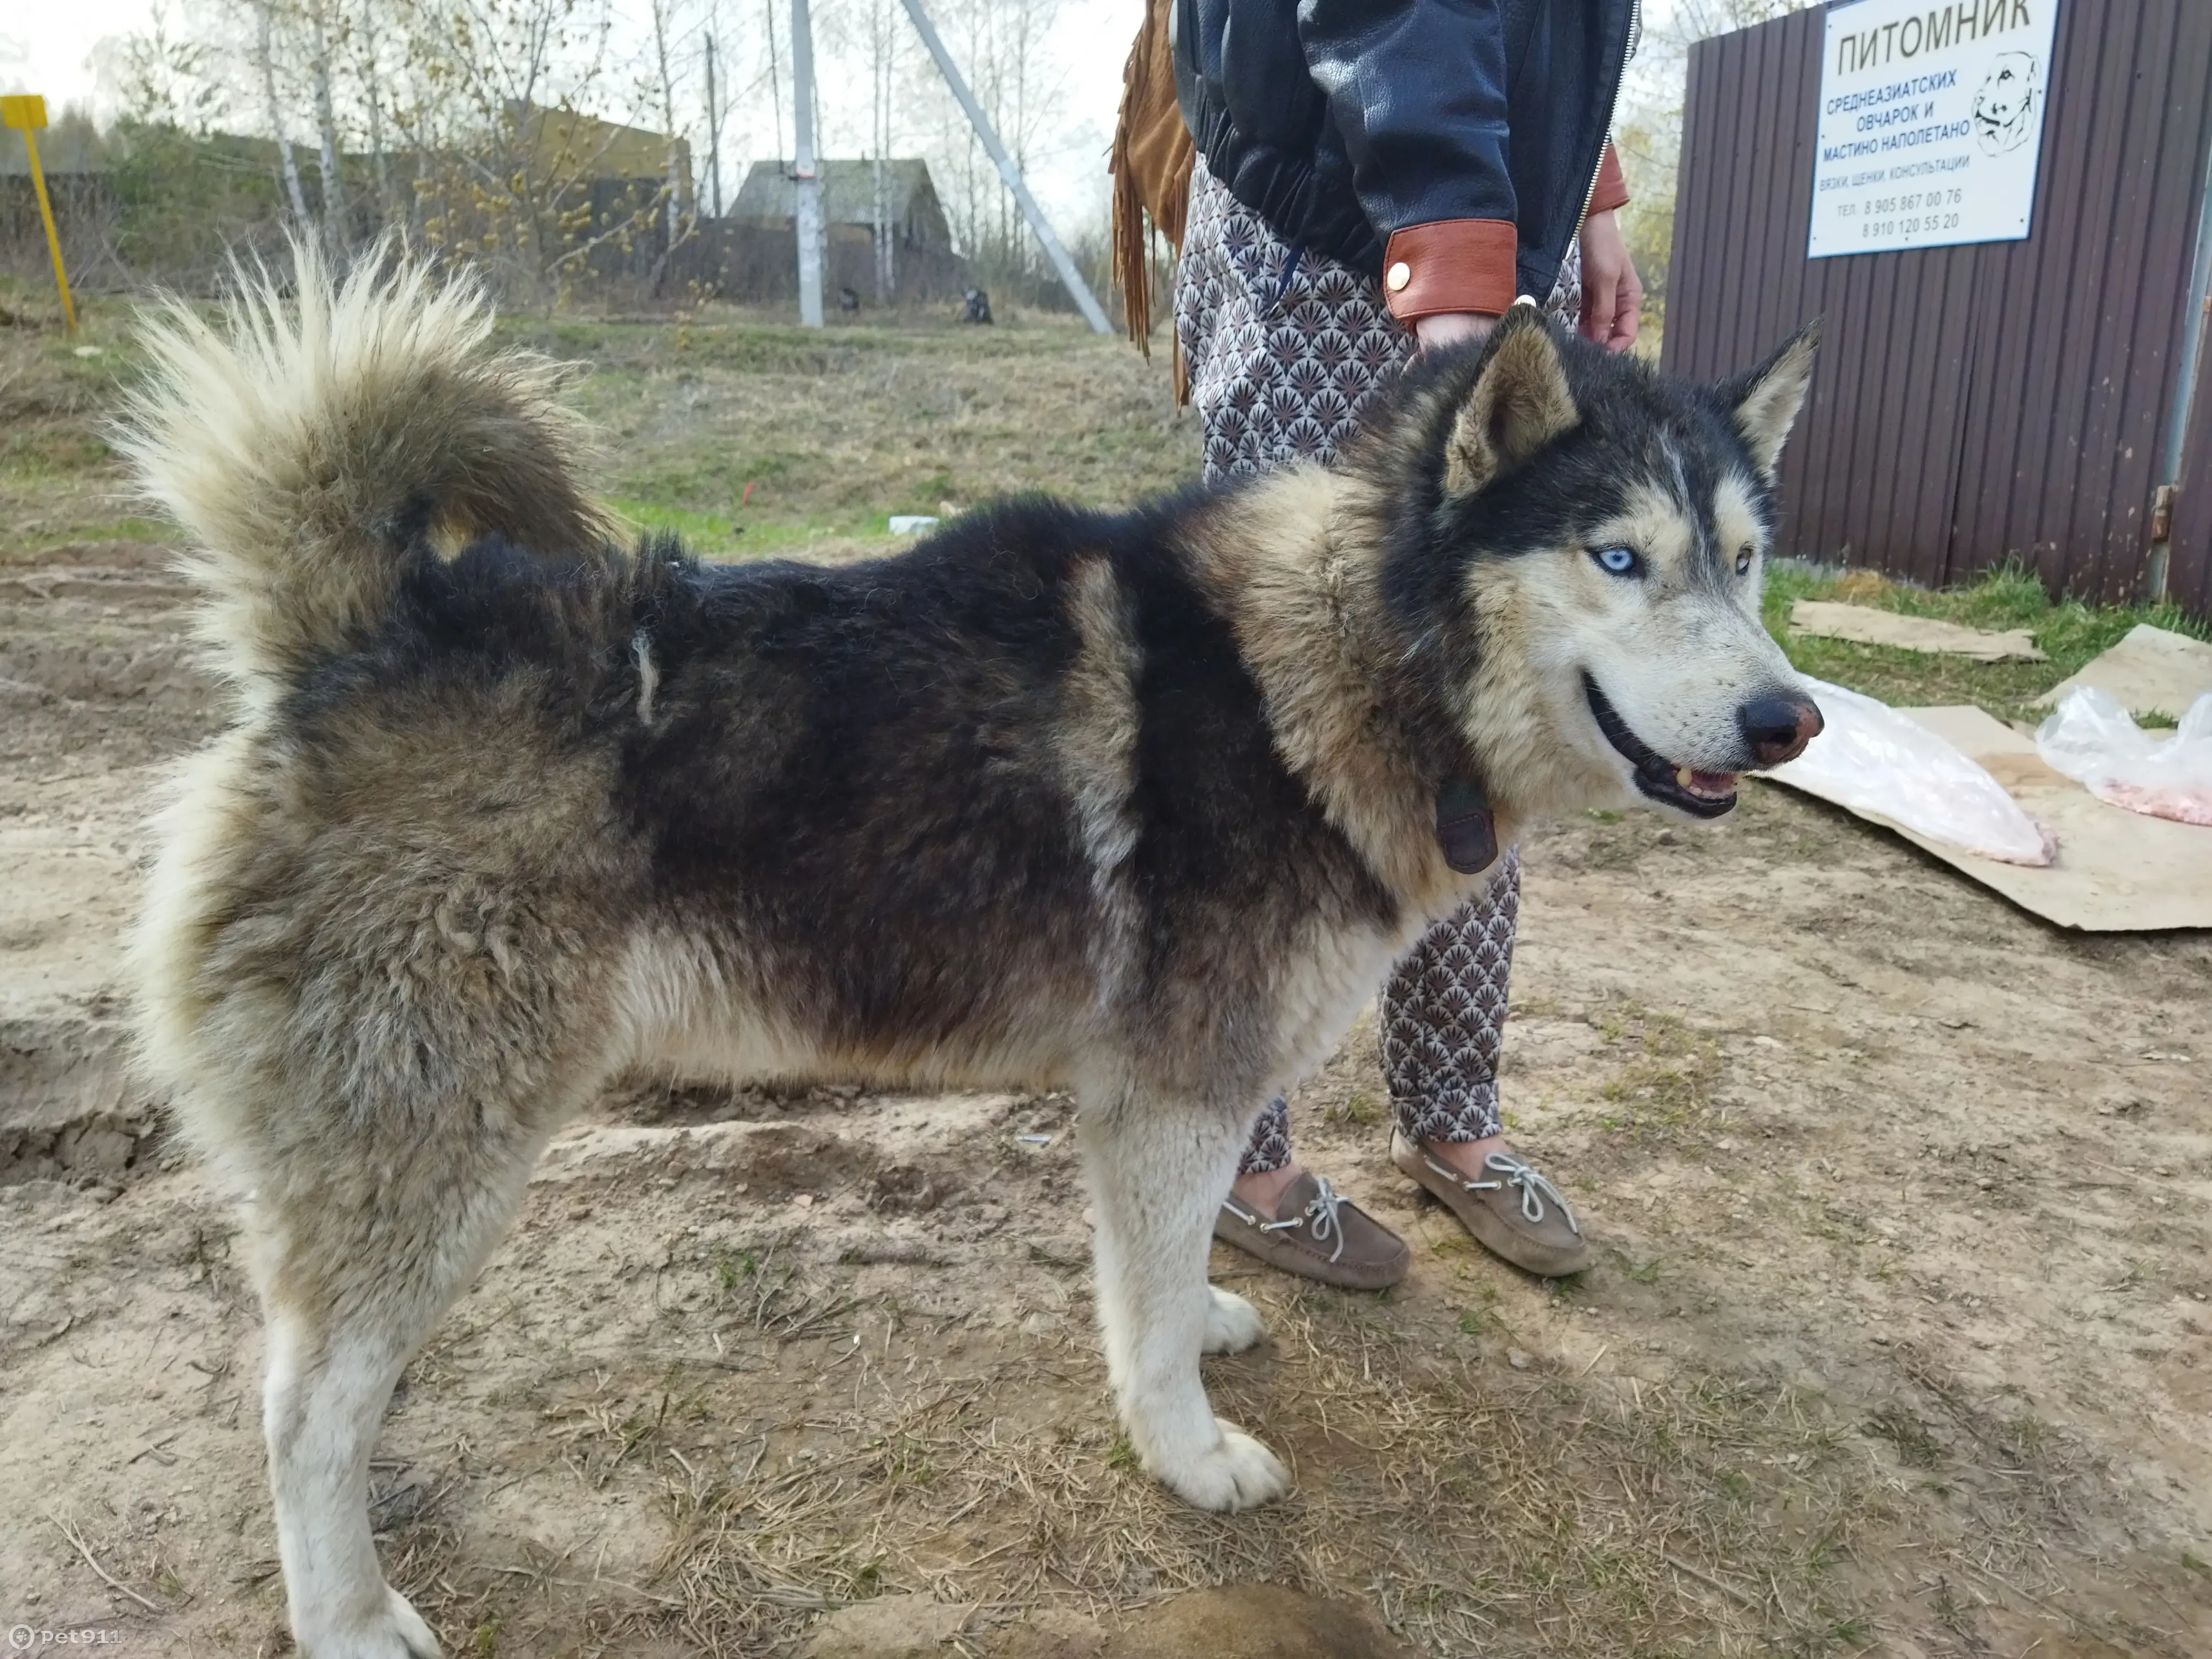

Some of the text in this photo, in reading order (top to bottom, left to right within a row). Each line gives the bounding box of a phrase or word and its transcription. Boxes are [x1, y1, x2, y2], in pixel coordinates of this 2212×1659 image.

[1838, 0, 2031, 76] ПИТОМНИК
[1827, 69, 1957, 115] СРЕДНЕАЗИАТСКИХ
[1857, 101, 1934, 132] ОВЧАРОК И
[1823, 119, 1970, 162] МАСТИНО НАПОЛЕТАНО
[1889, 155, 1970, 180] КОНСУЛЬТАЦИИ
[1864, 201, 1871, 215] 8
[1875, 197, 1896, 214] 905
[1900, 194, 1923, 211] 867
[1926, 191, 1942, 208] 00
[1947, 187, 1962, 205] 76
[1862, 212, 1959, 238] 8 910 120 55 20
